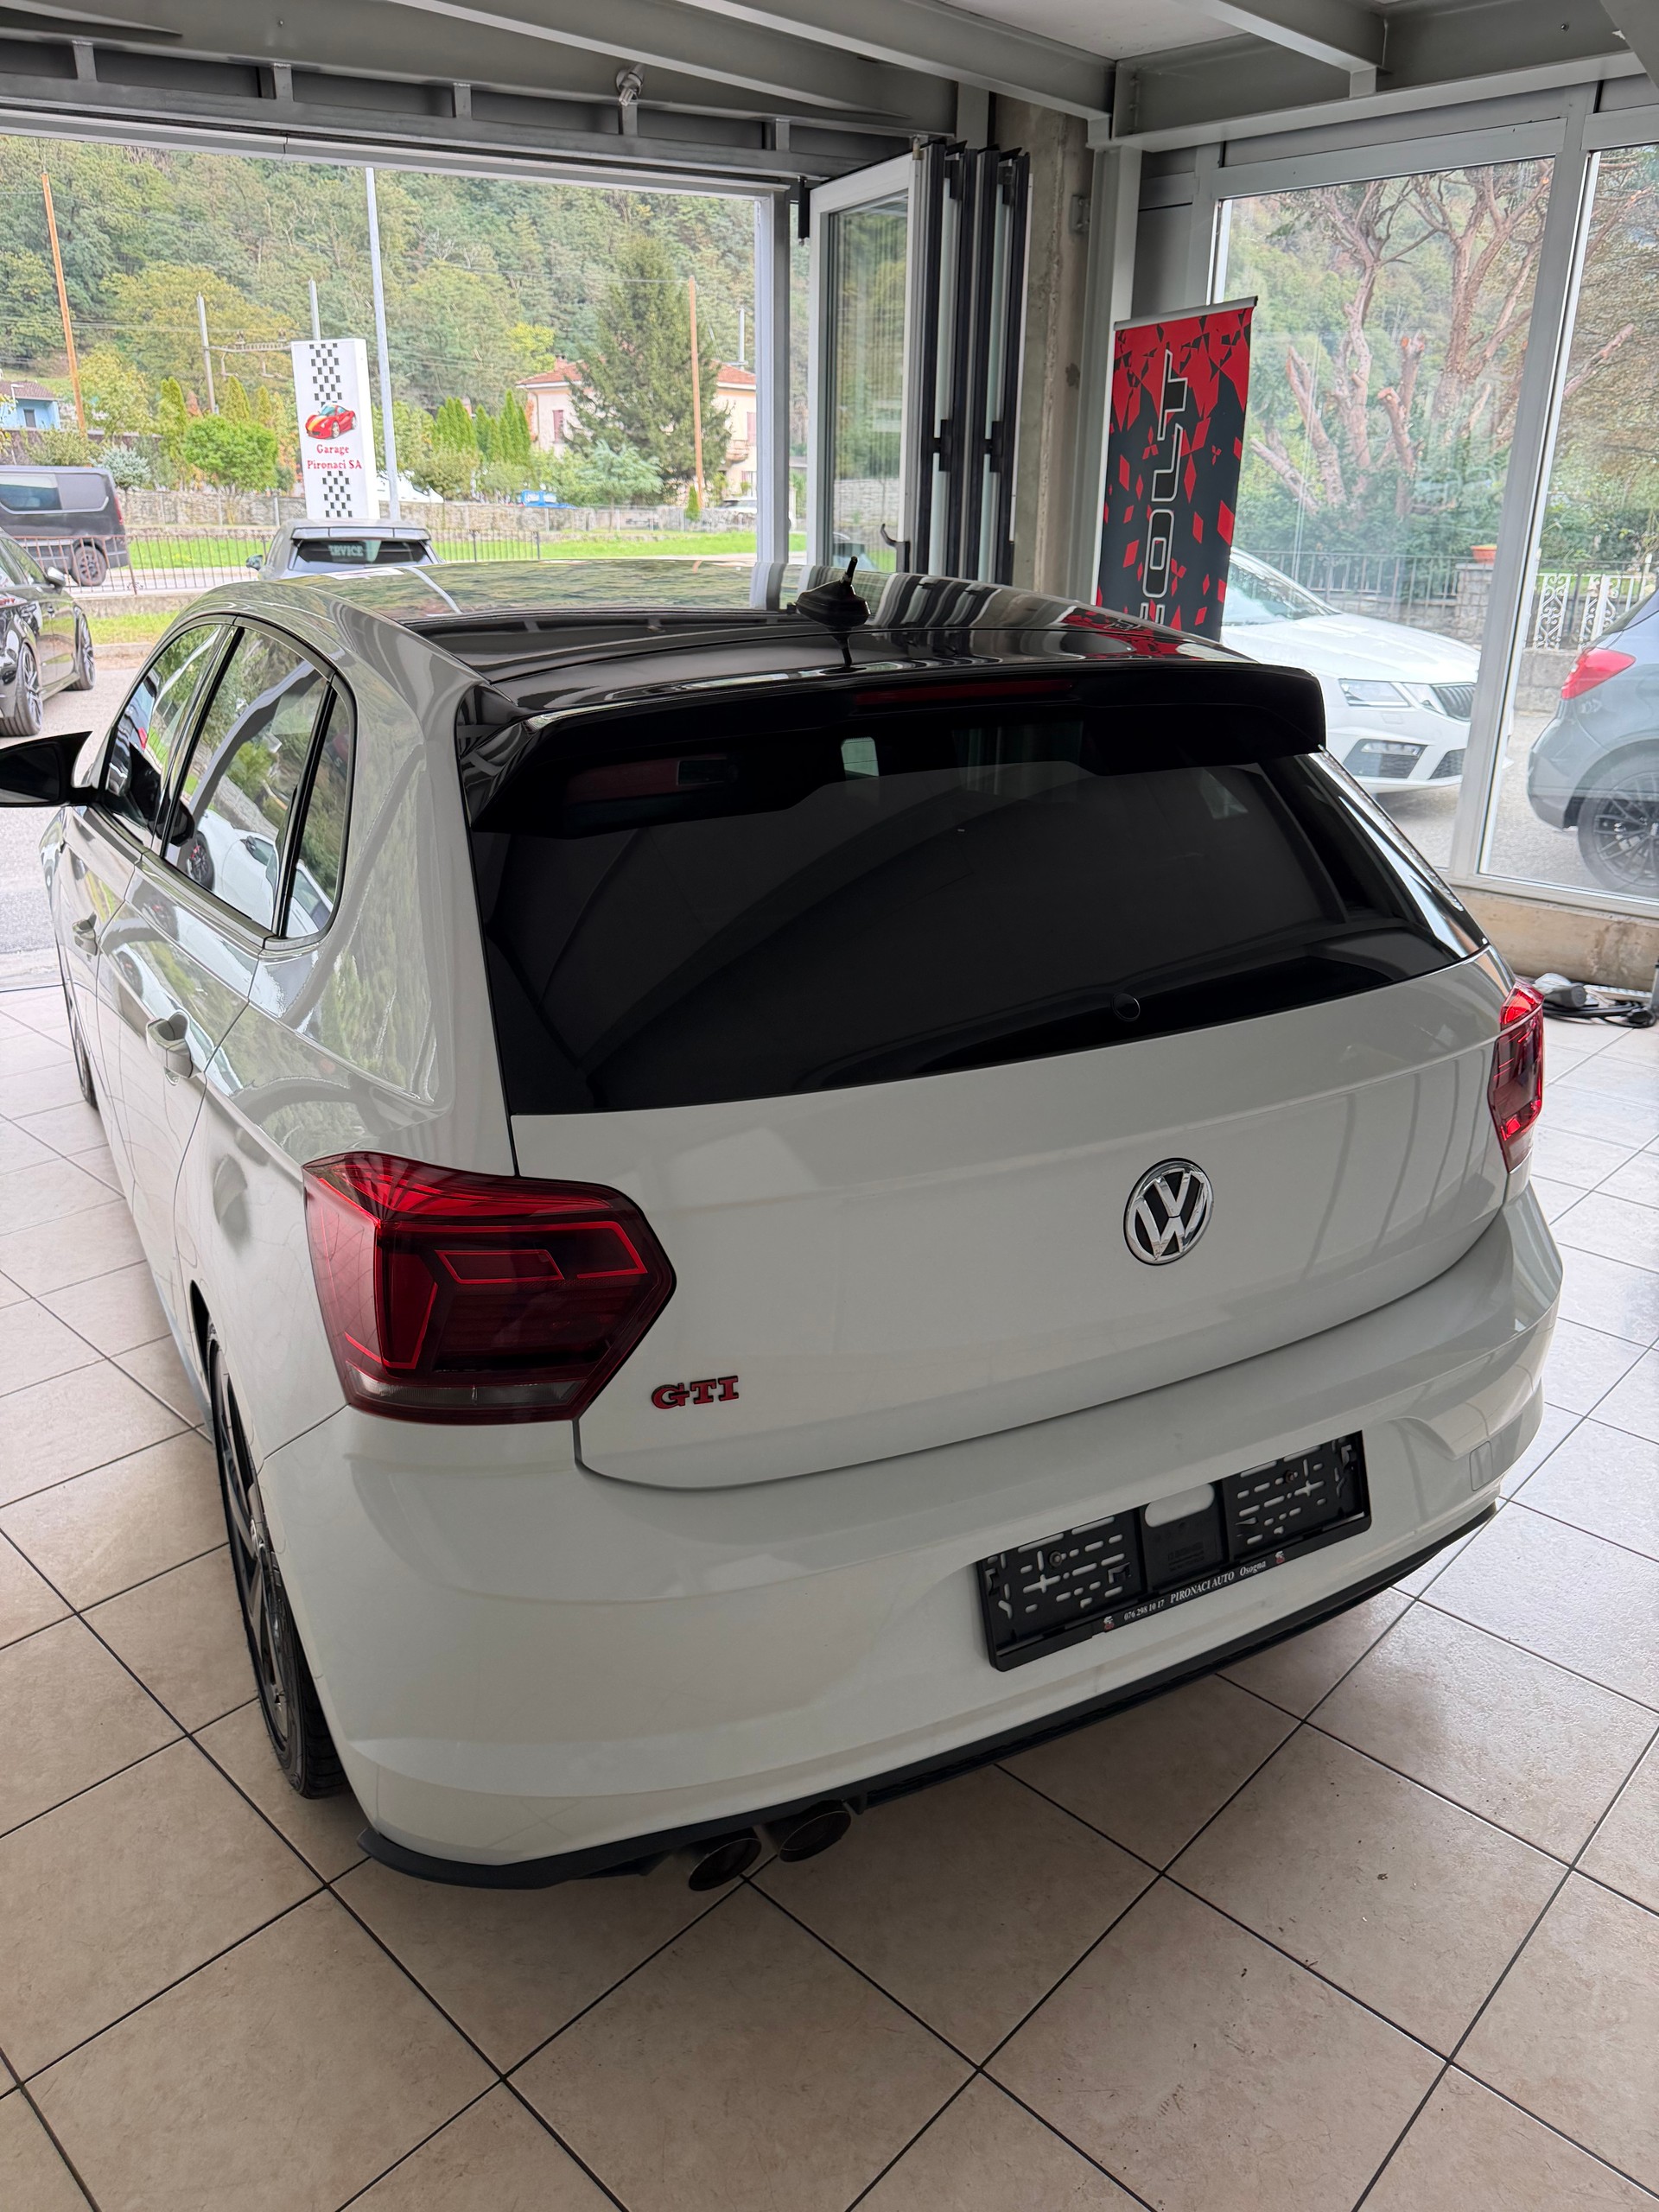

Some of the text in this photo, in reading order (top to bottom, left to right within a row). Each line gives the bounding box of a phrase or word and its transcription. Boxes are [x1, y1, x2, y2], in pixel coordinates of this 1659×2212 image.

[307, 460, 362, 469] Pironaci SA
[316, 444, 349, 455] Garage
[1139, 349, 1188, 625] OLT
[651, 1375, 740, 1409] GTI
[1124, 1560, 1267, 1621] 076 298 10 17 PIRONACI AUTO Osogna
